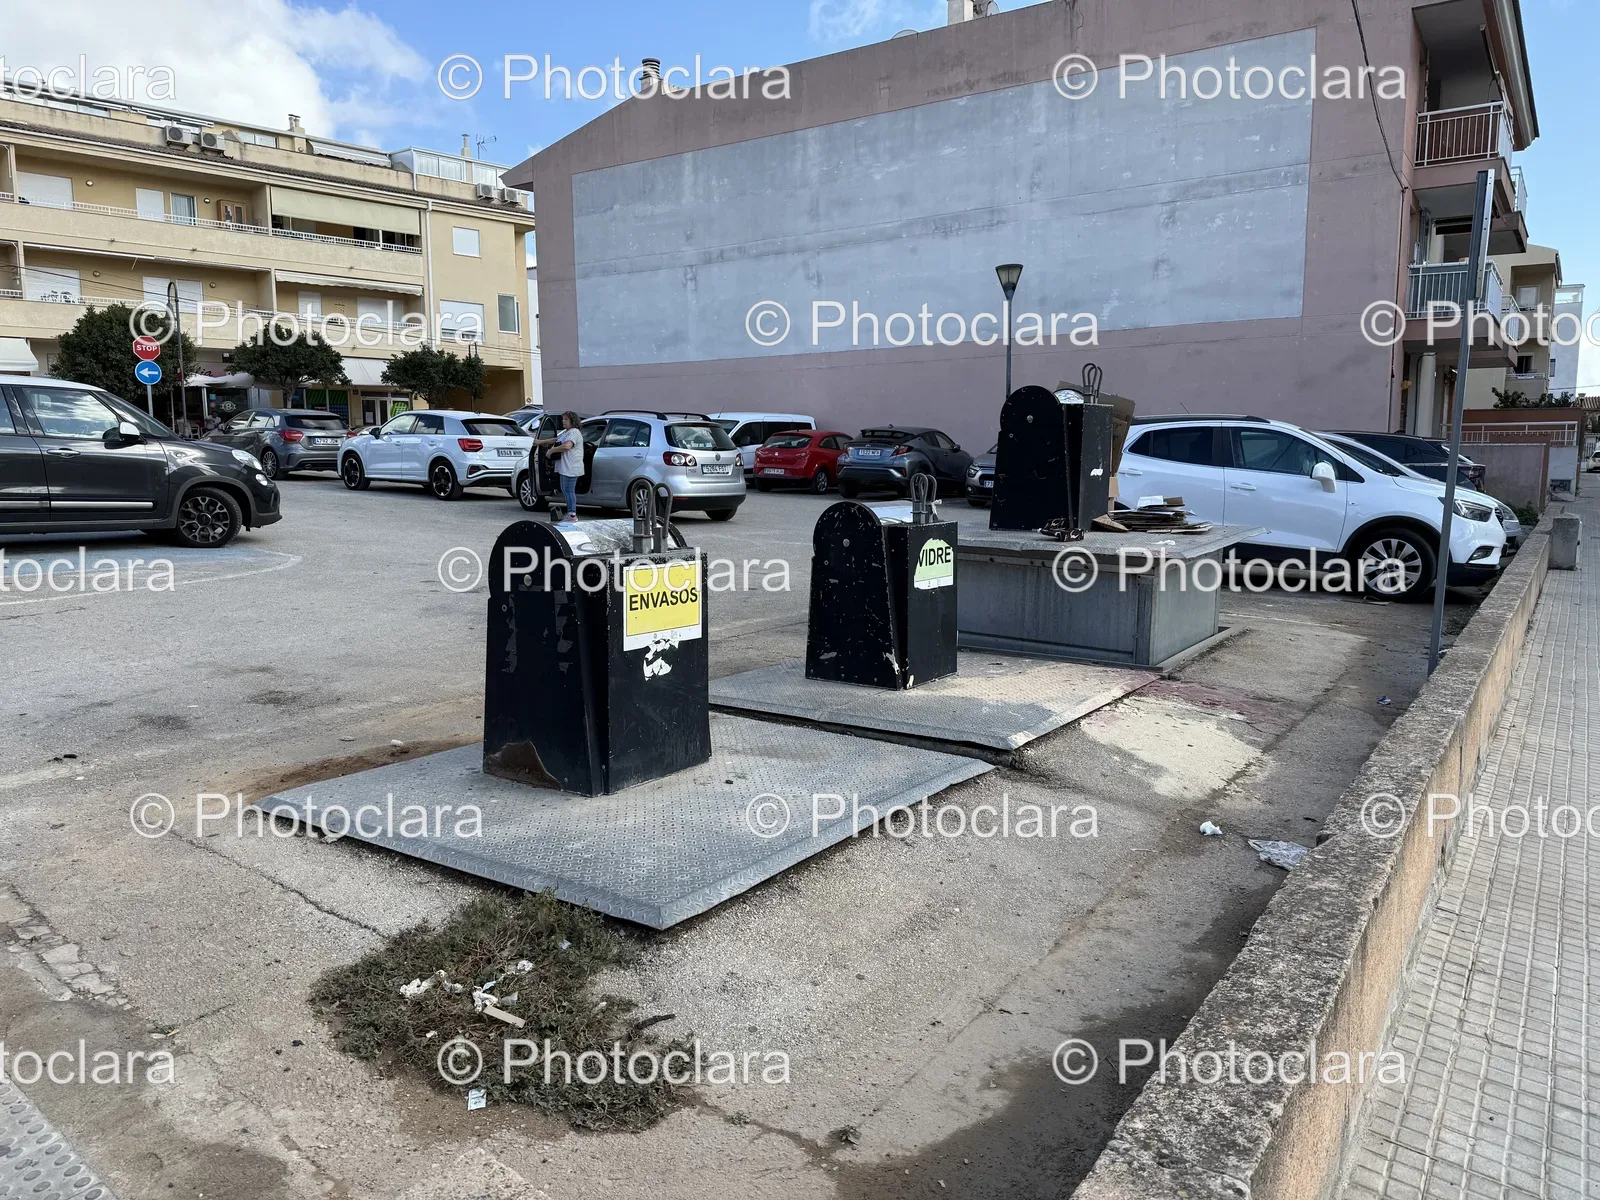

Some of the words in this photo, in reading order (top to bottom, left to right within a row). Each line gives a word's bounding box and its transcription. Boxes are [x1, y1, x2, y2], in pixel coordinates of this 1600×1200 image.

[136, 344, 158, 352] STOP
[918, 546, 952, 568] VIDRE
[629, 587, 698, 611] ENVASOS
